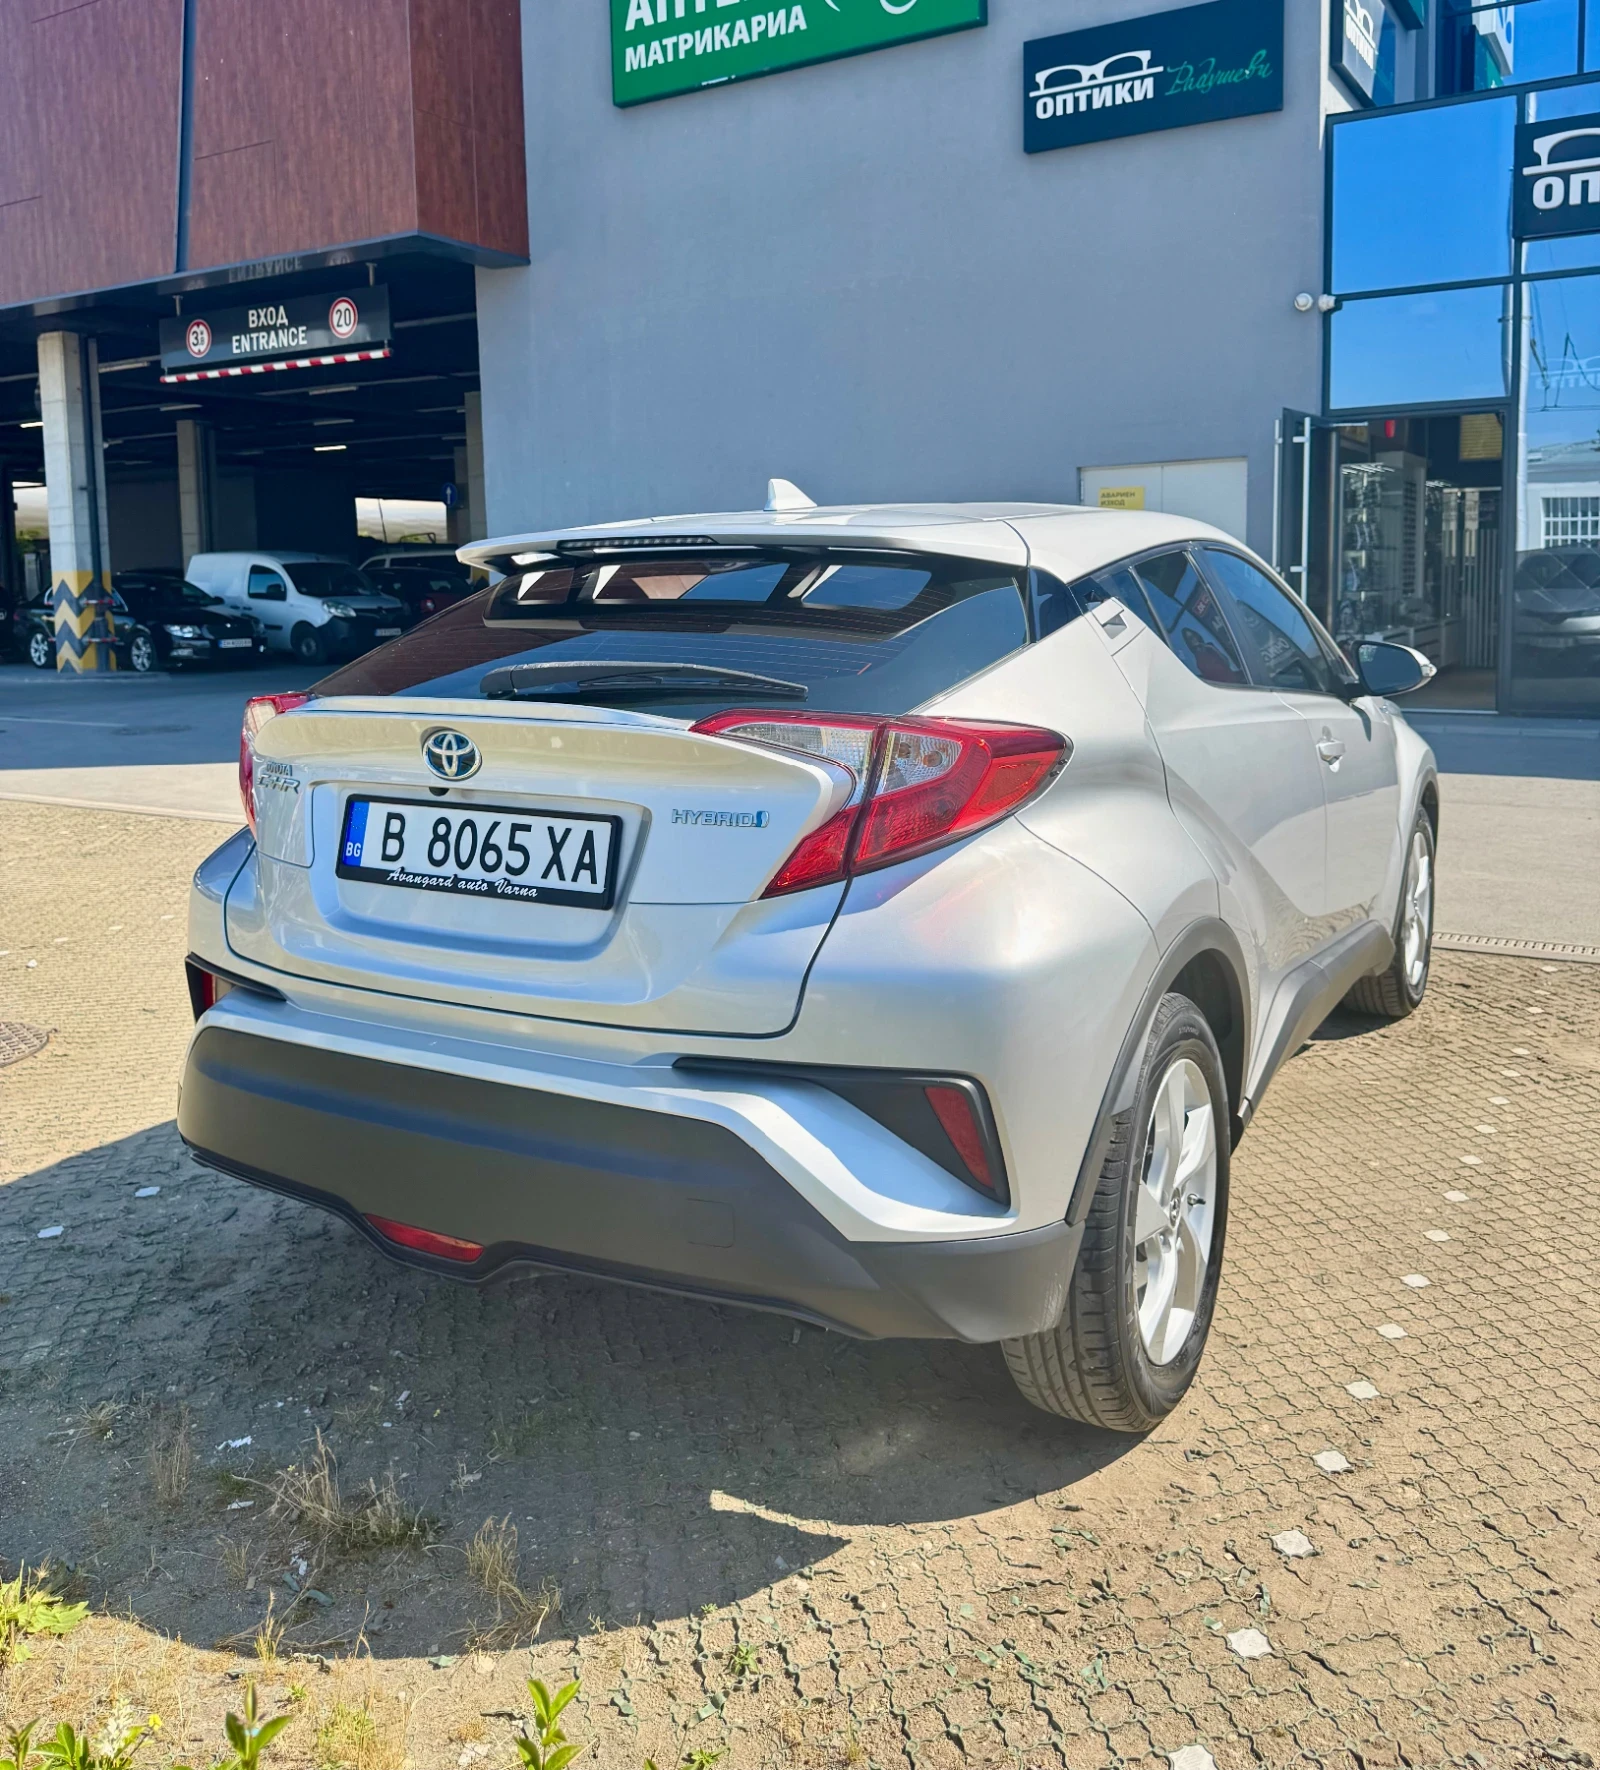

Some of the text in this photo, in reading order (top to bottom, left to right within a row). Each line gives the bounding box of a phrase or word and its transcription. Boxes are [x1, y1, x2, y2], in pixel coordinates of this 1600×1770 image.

[625, 5, 807, 72] МАТРИКАРИА
[1035, 77, 1154, 119] ОПТИКИ
[1532, 171, 1600, 209] ОП
[248, 305, 288, 329] ВХОД
[335, 307, 352, 328] 20
[232, 326, 307, 354] ENTRANCE
[671, 808, 754, 828] HYBRID
[345, 841, 361, 858] BG
[380, 811, 598, 885] B 8065 XA
[386, 866, 539, 898] Avangard auto Varna
